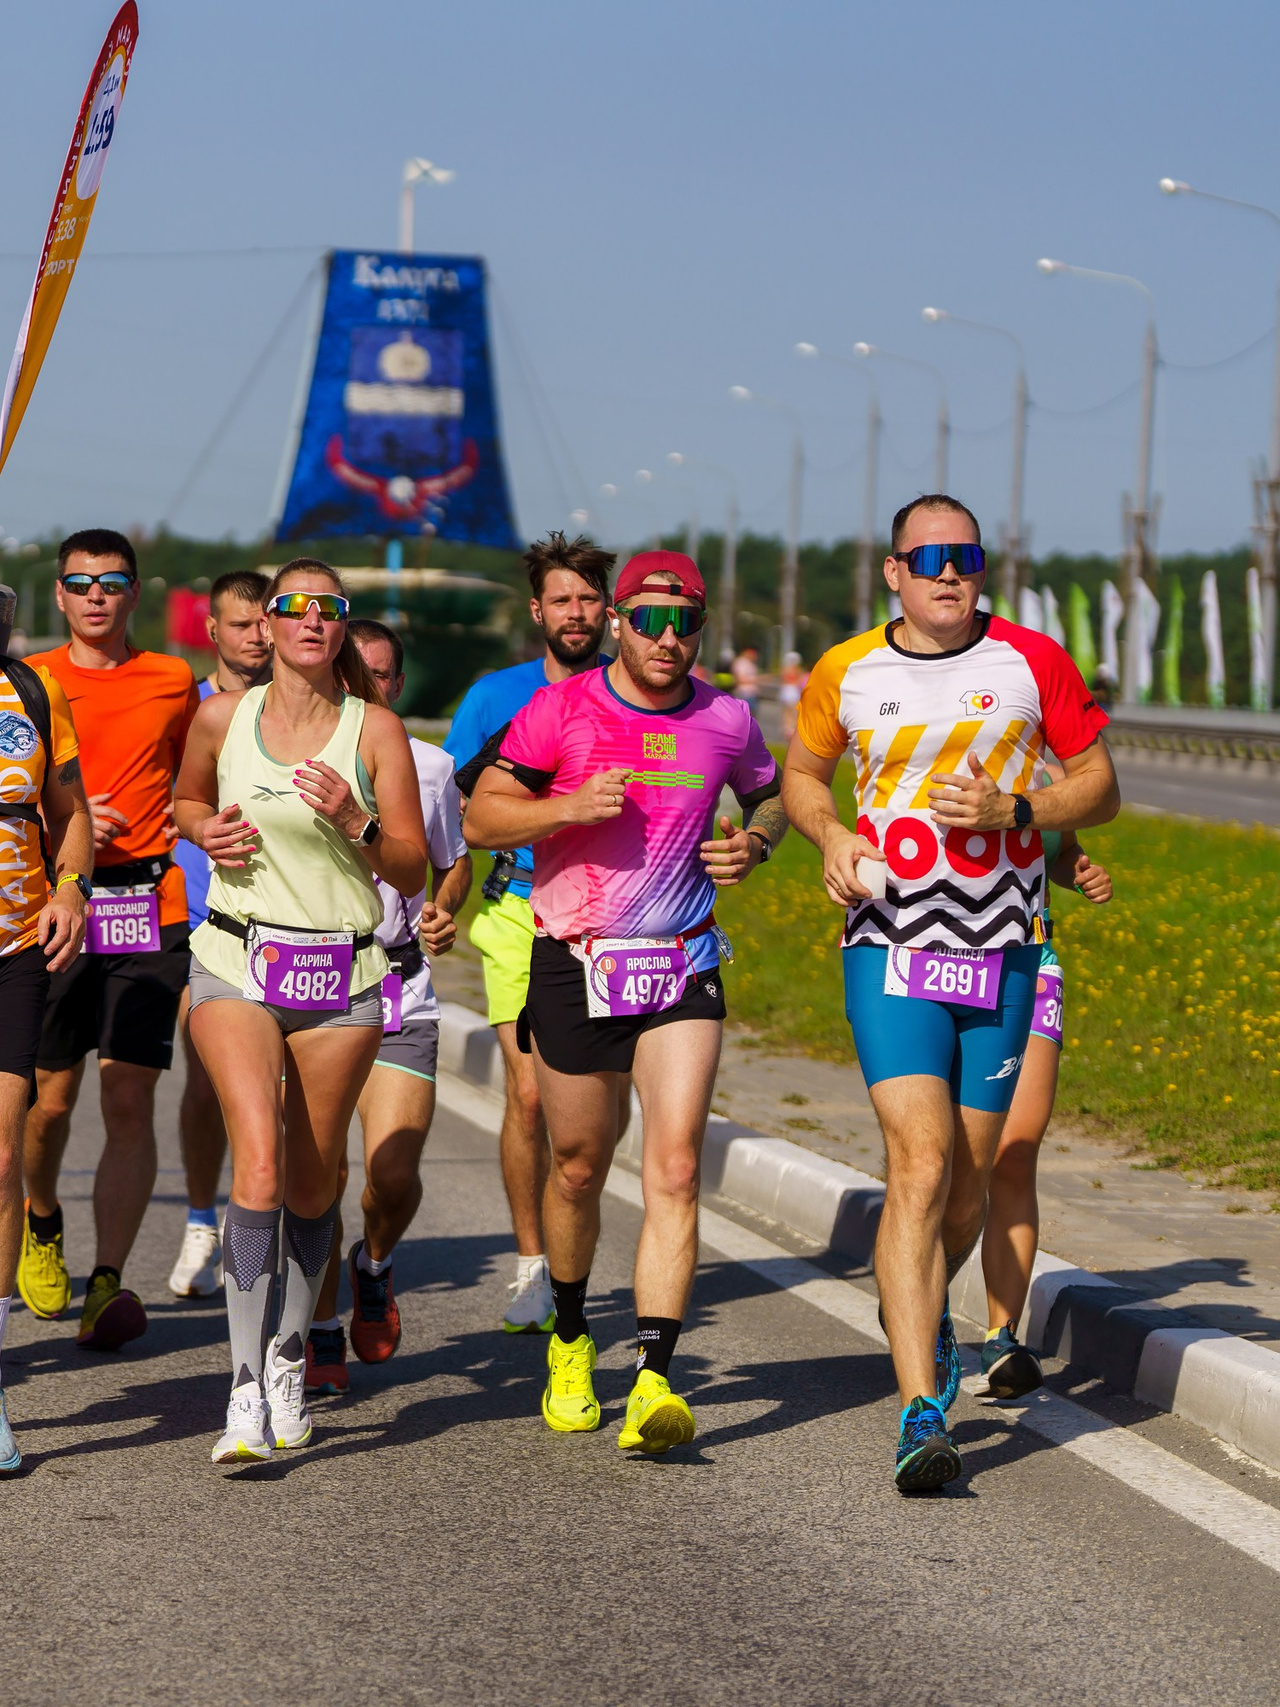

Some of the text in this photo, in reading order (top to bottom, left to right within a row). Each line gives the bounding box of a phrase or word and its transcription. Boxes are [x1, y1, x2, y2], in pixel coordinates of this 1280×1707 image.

[879, 701, 901, 716] GRi
[643, 732, 676, 744] БЕЛЫЕ
[643, 743, 677, 755] НОЧИ
[643, 753, 677, 761] МАРАФОН
[95, 902, 150, 916] АЛЕКСАНДР
[99, 917, 152, 946] 1695
[293, 953, 333, 967] КАРИНА
[627, 956, 672, 971] ЯРОСЛАВ
[278, 970, 341, 1001] 4982
[923, 960, 988, 998] 2691
[622, 973, 677, 1006] 4973
